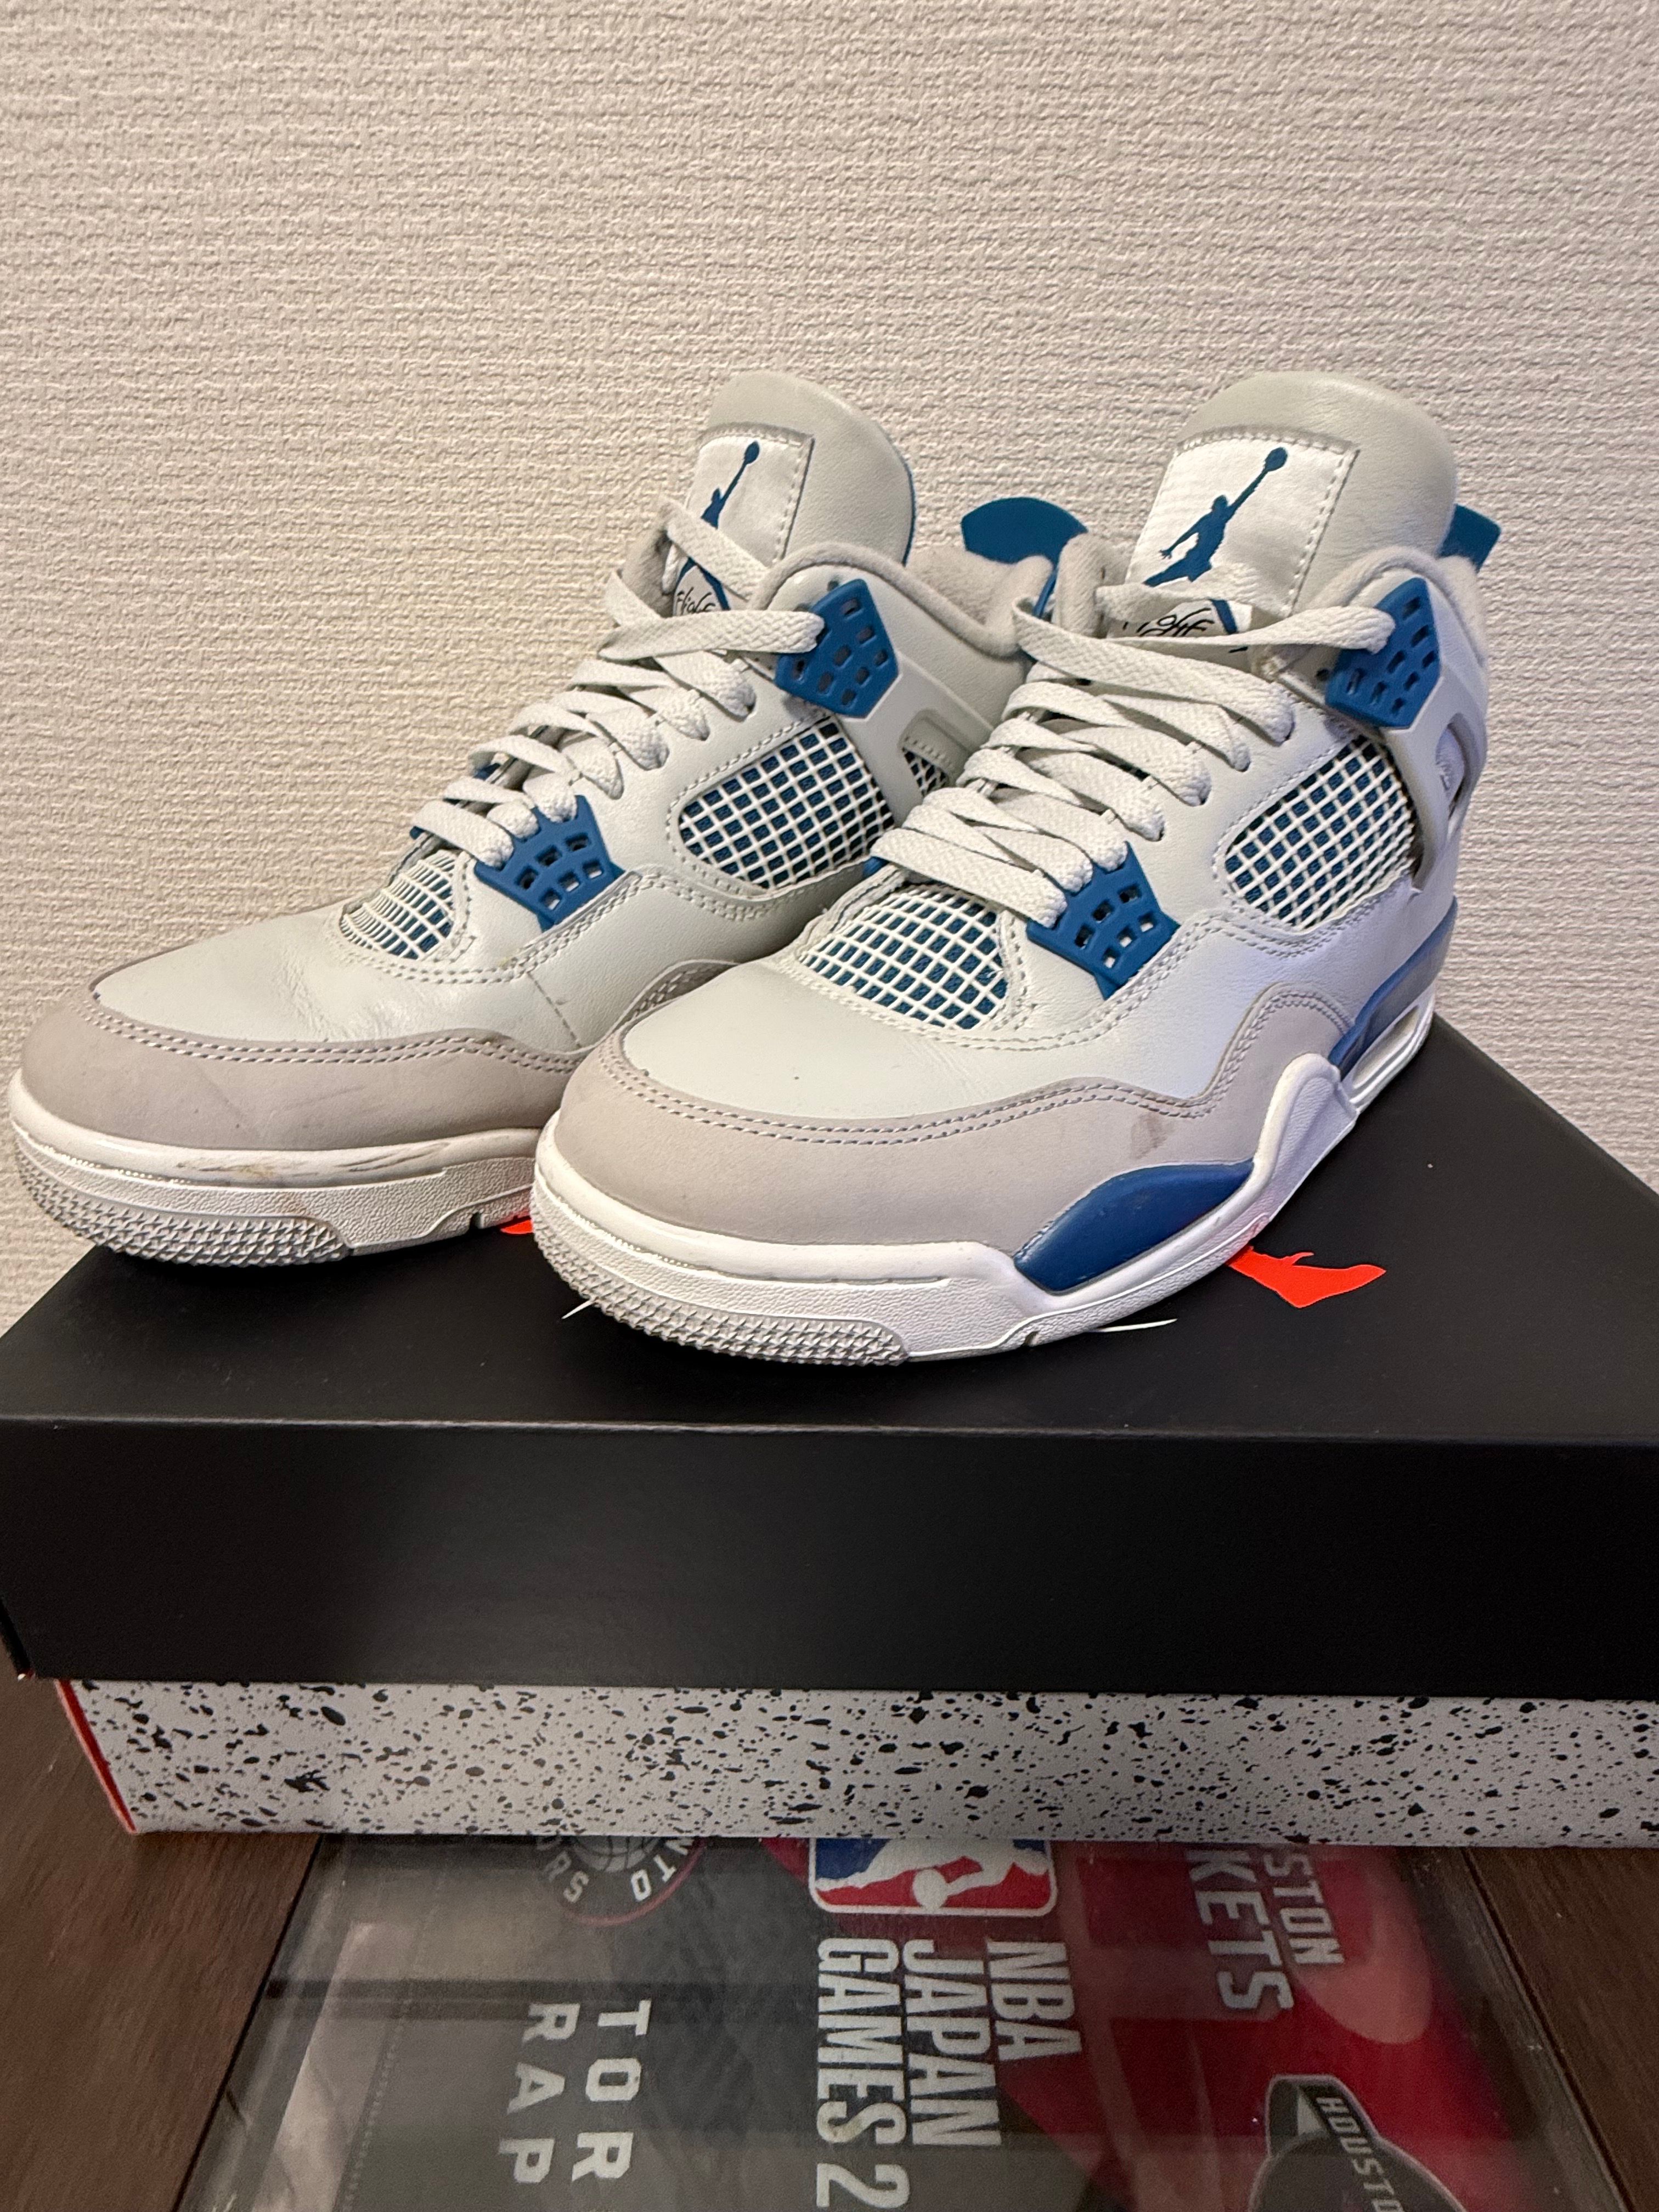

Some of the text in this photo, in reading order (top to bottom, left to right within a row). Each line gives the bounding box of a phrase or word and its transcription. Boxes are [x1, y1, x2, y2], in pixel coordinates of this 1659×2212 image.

[986, 1937, 1082, 2061] NBA
[1185, 1849, 1295, 2010] KETS
[498, 2003, 580, 2183] RAP
[572, 1999, 651, 2181] TOR
[817, 1937, 907, 2143] GAMES
[903, 1938, 1002, 2146] JAPAN
